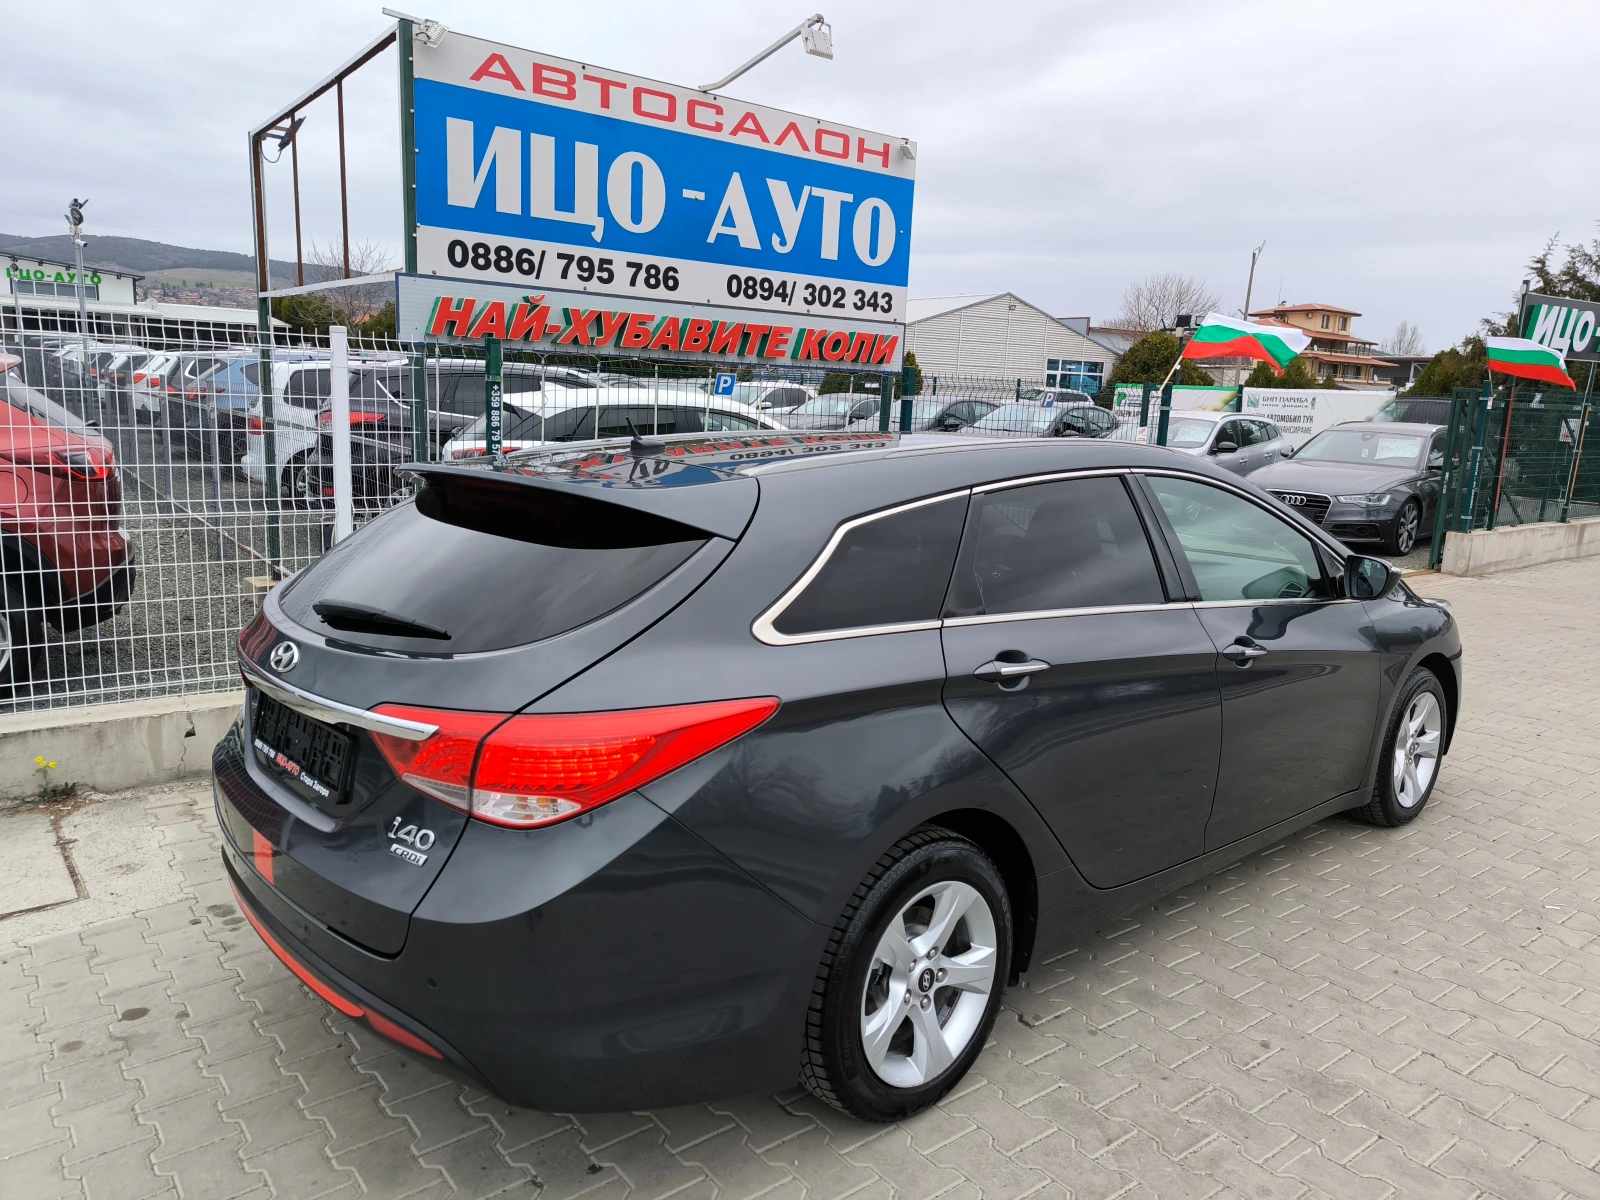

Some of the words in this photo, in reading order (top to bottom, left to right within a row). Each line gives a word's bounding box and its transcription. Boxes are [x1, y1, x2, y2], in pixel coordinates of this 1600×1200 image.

[470, 53, 891, 169] АВТОСАЛОН
[447, 239, 546, 281] 0886/
[556, 252, 615, 285] 795
[626, 261, 680, 292] 786
[726, 273, 797, 308] 0894/
[803, 283, 846, 309] 302
[852, 289, 893, 314] 343
[427, 294, 794, 360] НАЙ-ХУБАВИТЕ
[797, 328, 900, 365] КОЛИ
[1530, 304, 1600, 358] ИЦО
[490, 384, 501, 408] +359
[490, 409, 500, 428] 886
[491, 429, 500, 444] 79
[387, 816, 436, 851] i40
[392, 847, 423, 864] CRDi
